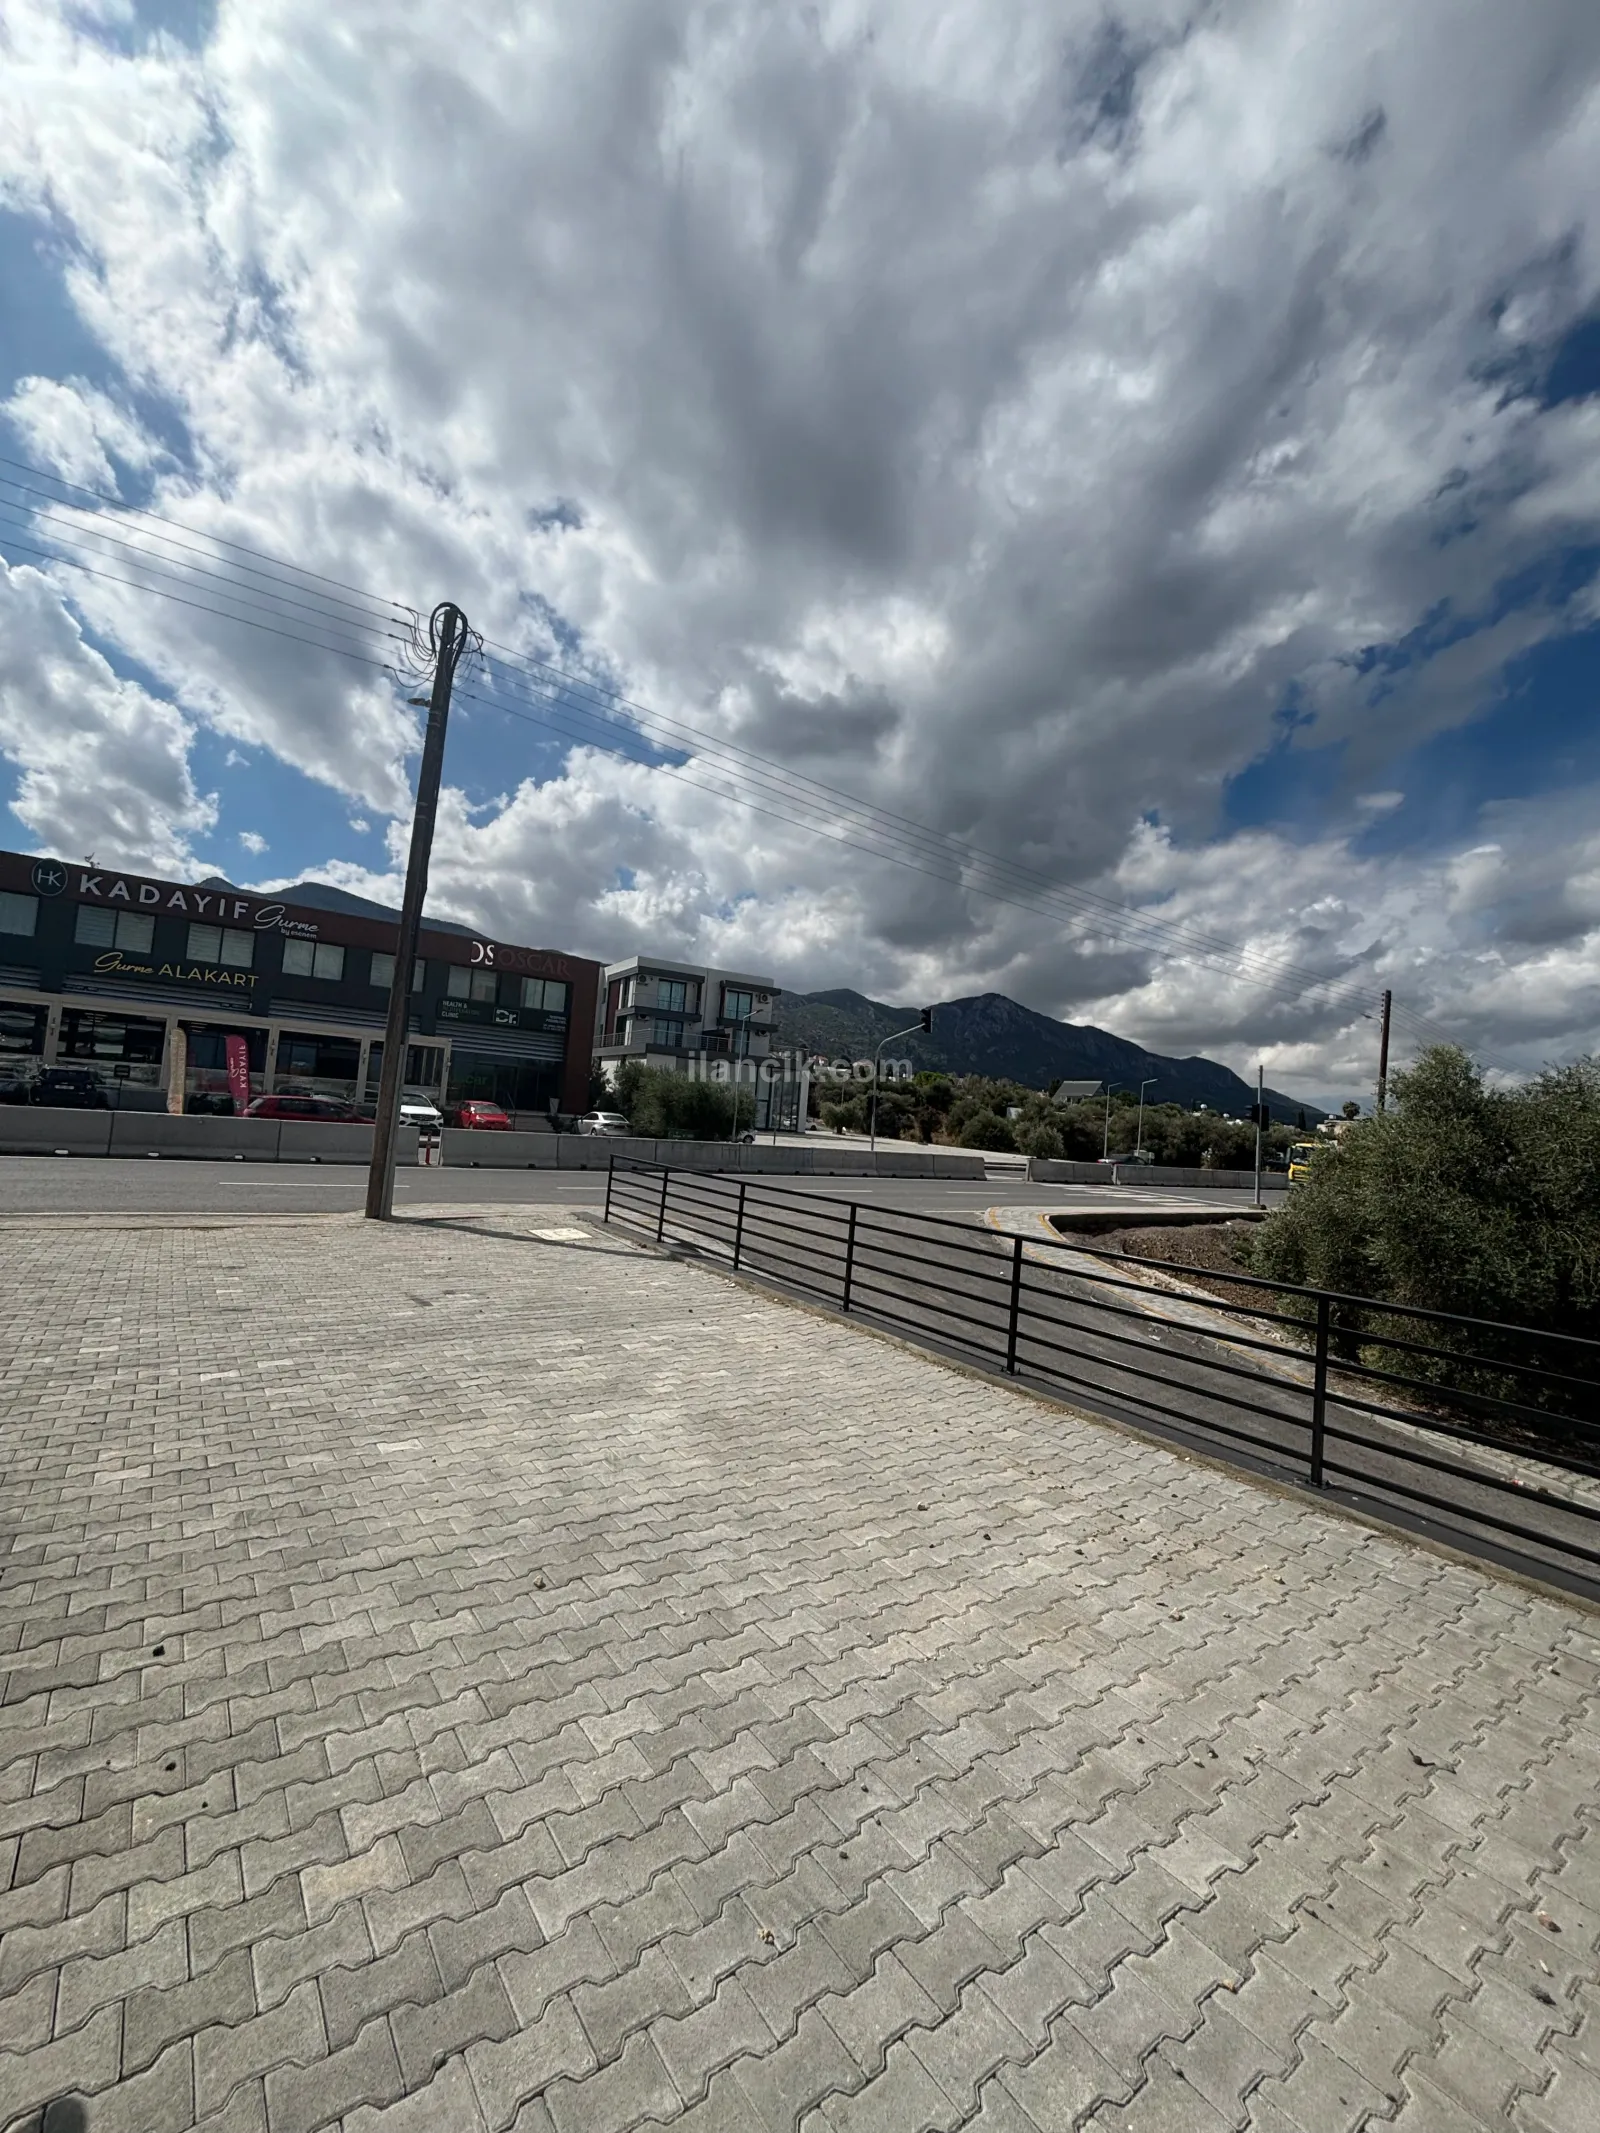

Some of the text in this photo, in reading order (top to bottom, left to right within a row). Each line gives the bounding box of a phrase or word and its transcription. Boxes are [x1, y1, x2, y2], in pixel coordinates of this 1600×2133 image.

[37, 868, 62, 887] HK
[79, 873, 320, 933] KADAYIF Gurme
[93, 951, 260, 988] Gurme ALAKART
[498, 949, 571, 977] OSCAR
